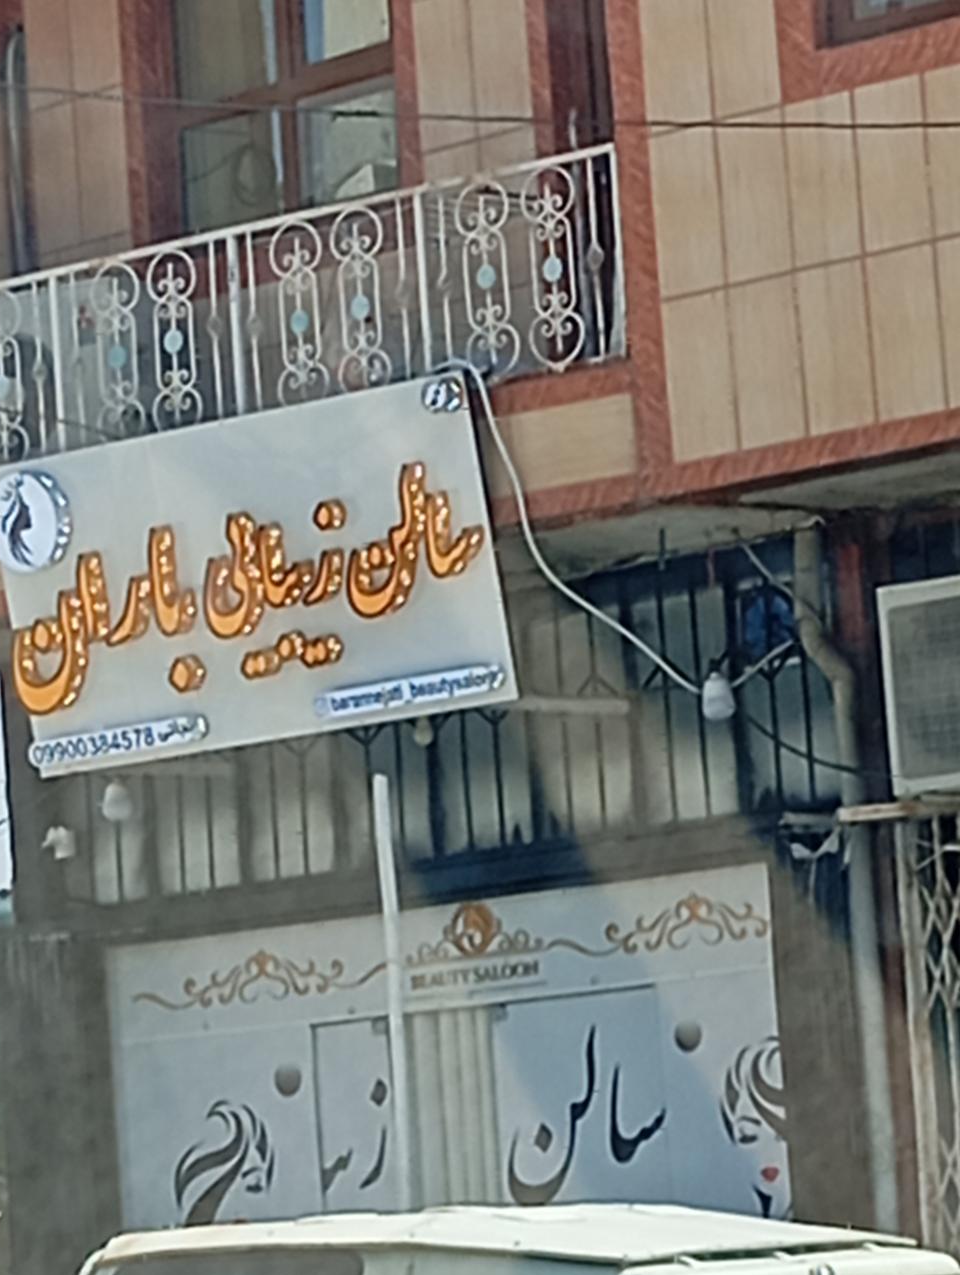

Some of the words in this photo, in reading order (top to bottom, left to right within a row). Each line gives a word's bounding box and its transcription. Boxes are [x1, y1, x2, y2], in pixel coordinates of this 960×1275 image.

[11, 524, 207, 716] باران
[346, 460, 486, 619] سالن
[507, 1023, 668, 1208] سالن
